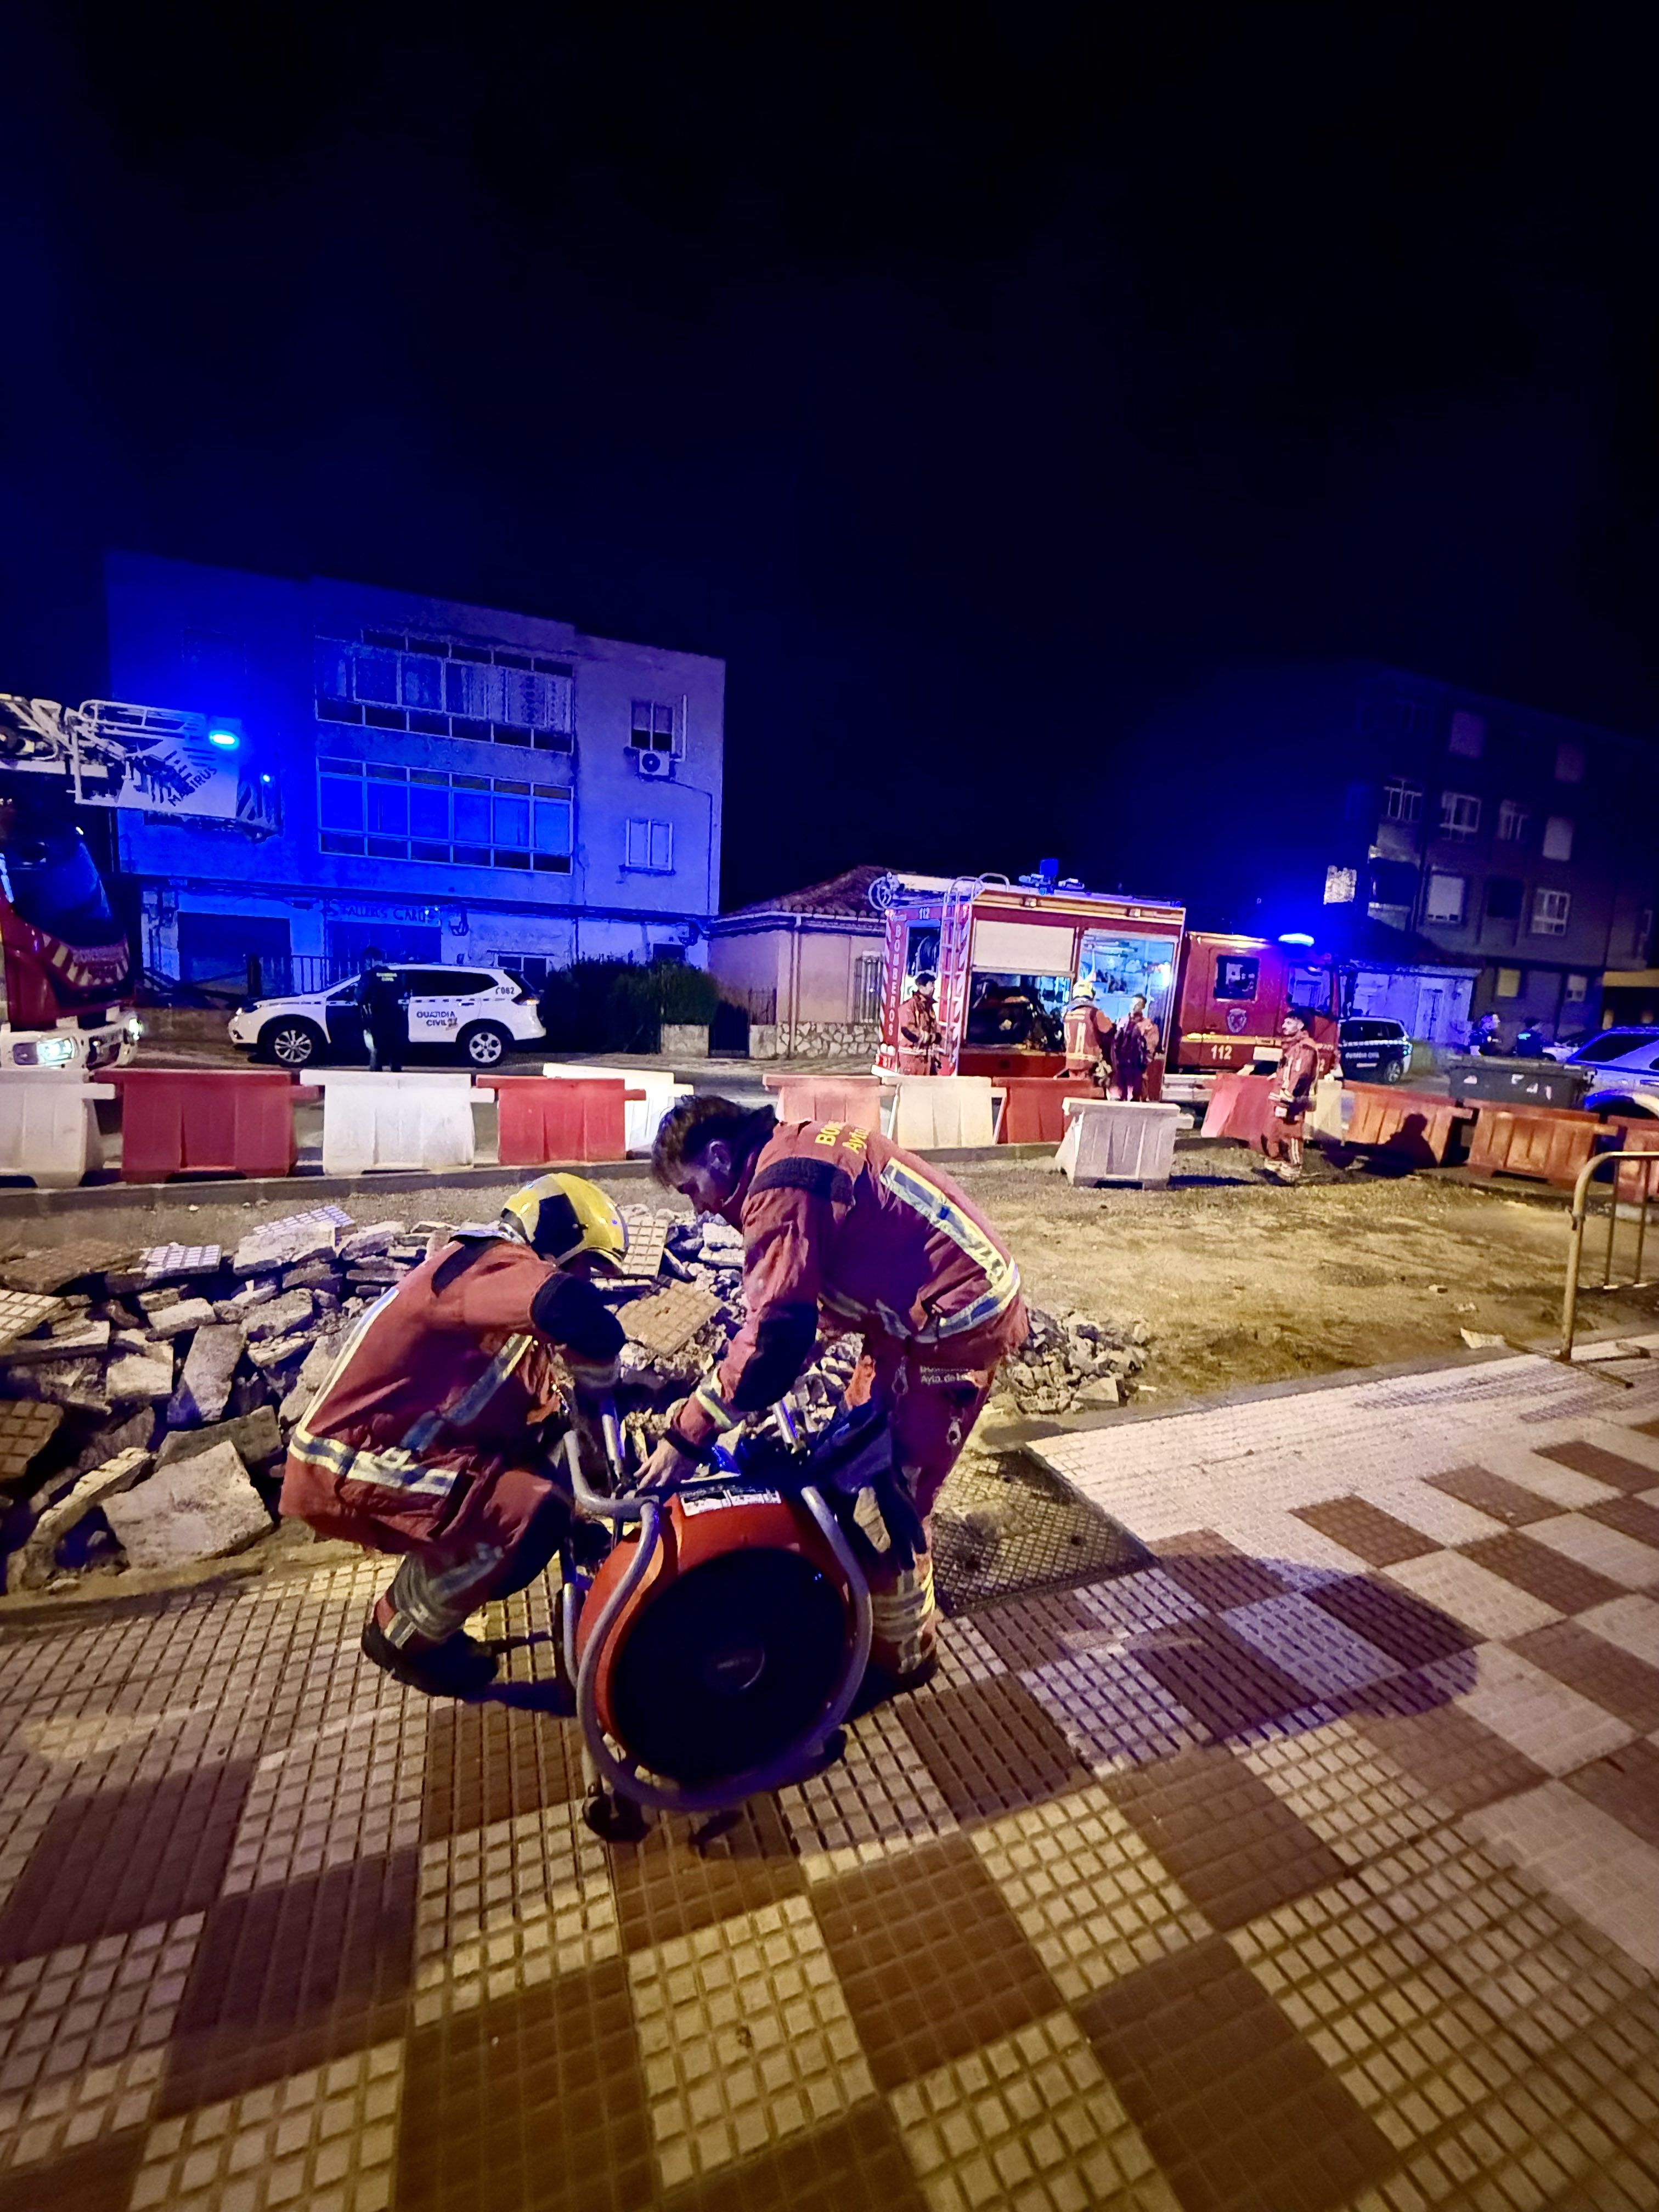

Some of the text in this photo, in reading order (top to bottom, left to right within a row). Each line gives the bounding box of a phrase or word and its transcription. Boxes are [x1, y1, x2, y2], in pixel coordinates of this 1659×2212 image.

[919, 907, 930, 919] 112
[888, 924, 901, 1036] BOMBEROS
[1211, 1045, 1232, 1060] 112
